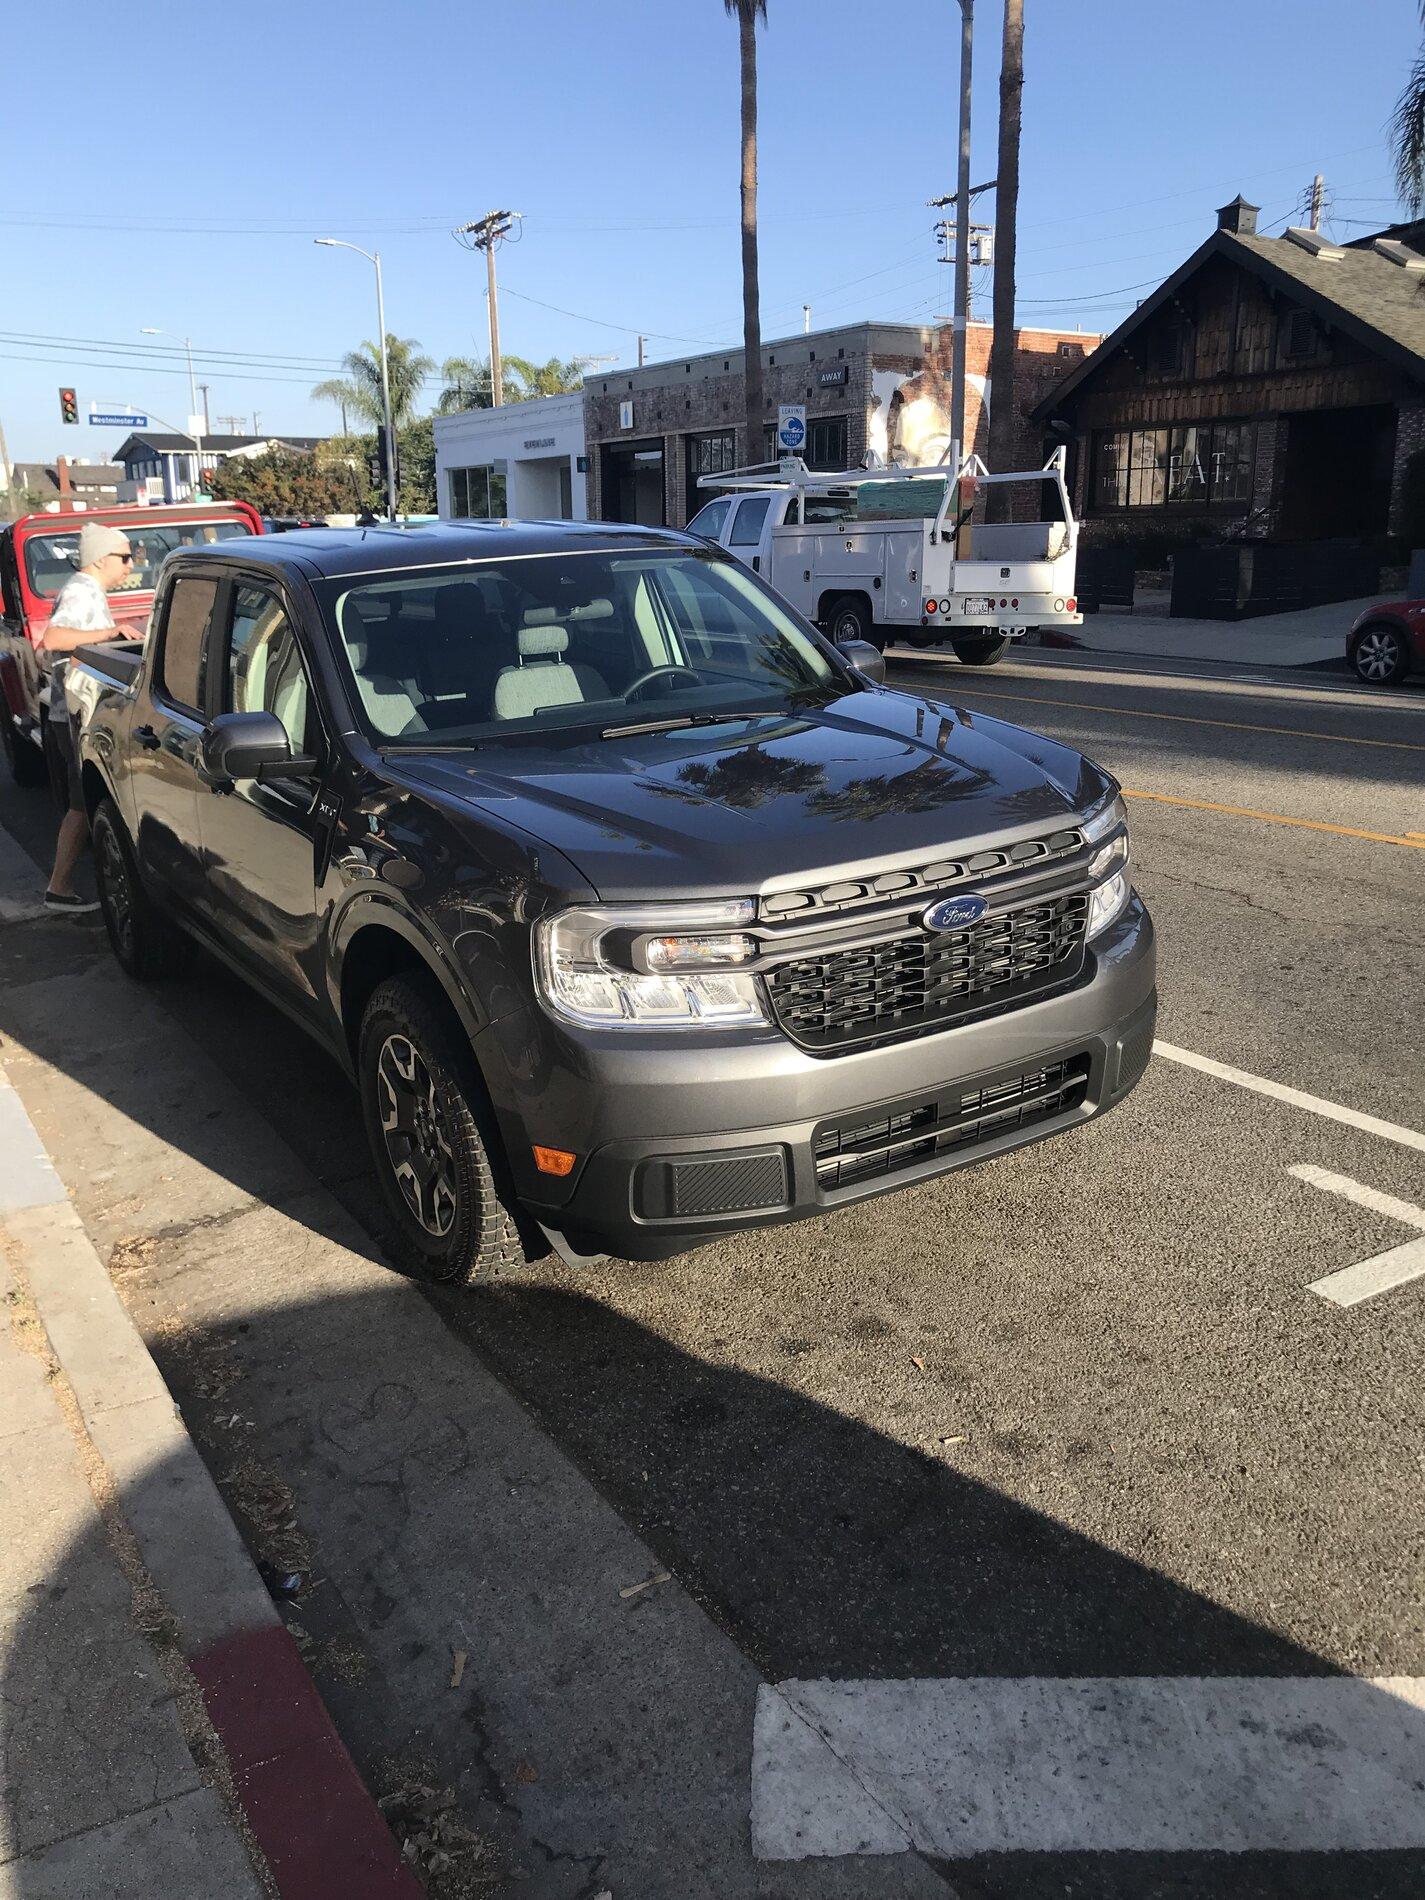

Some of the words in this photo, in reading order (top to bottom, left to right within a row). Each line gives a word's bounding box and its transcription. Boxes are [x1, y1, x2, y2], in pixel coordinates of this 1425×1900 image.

[821, 371, 842, 382] AWAY
[782, 407, 802, 415] LEAVING
[92, 416, 134, 425] Westminster
[942, 903, 977, 925] Ford
